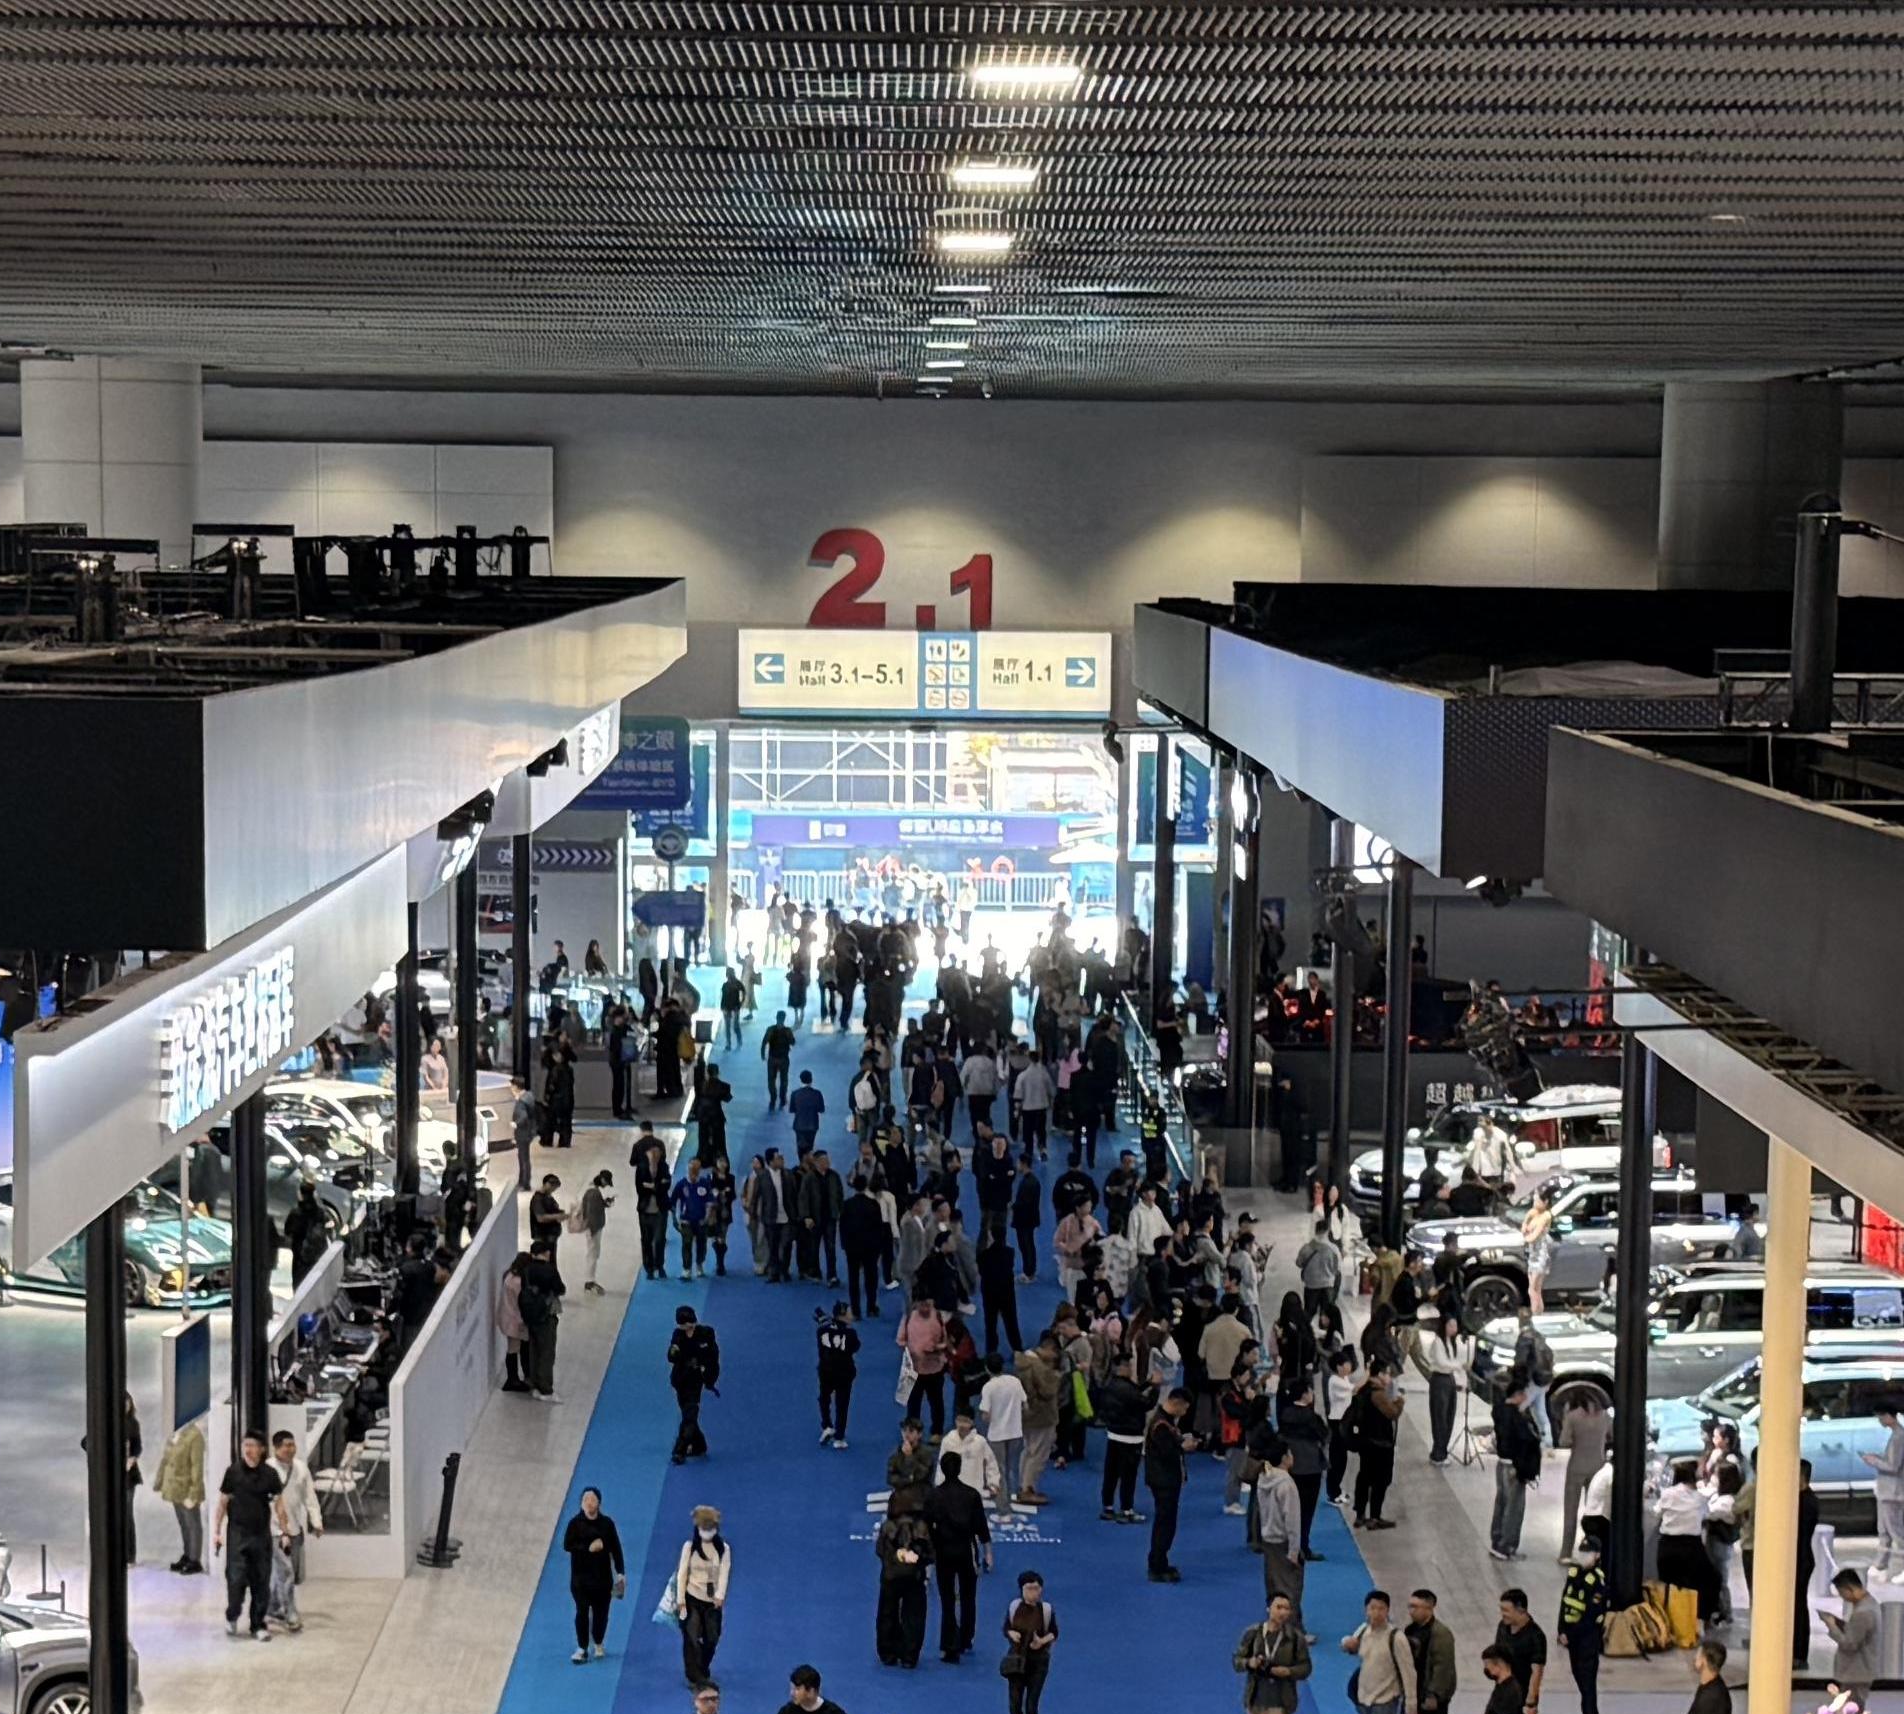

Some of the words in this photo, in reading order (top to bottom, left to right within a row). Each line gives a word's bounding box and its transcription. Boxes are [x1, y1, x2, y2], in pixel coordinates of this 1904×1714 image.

[806, 528, 993, 630] 2.1
[799, 660, 826, 673] 展厅
[992, 658, 1019, 671] 展厅
[993, 671, 1019, 684] Hall
[1024, 660, 1052, 682] 1.1
[799, 673, 826, 686] Hall
